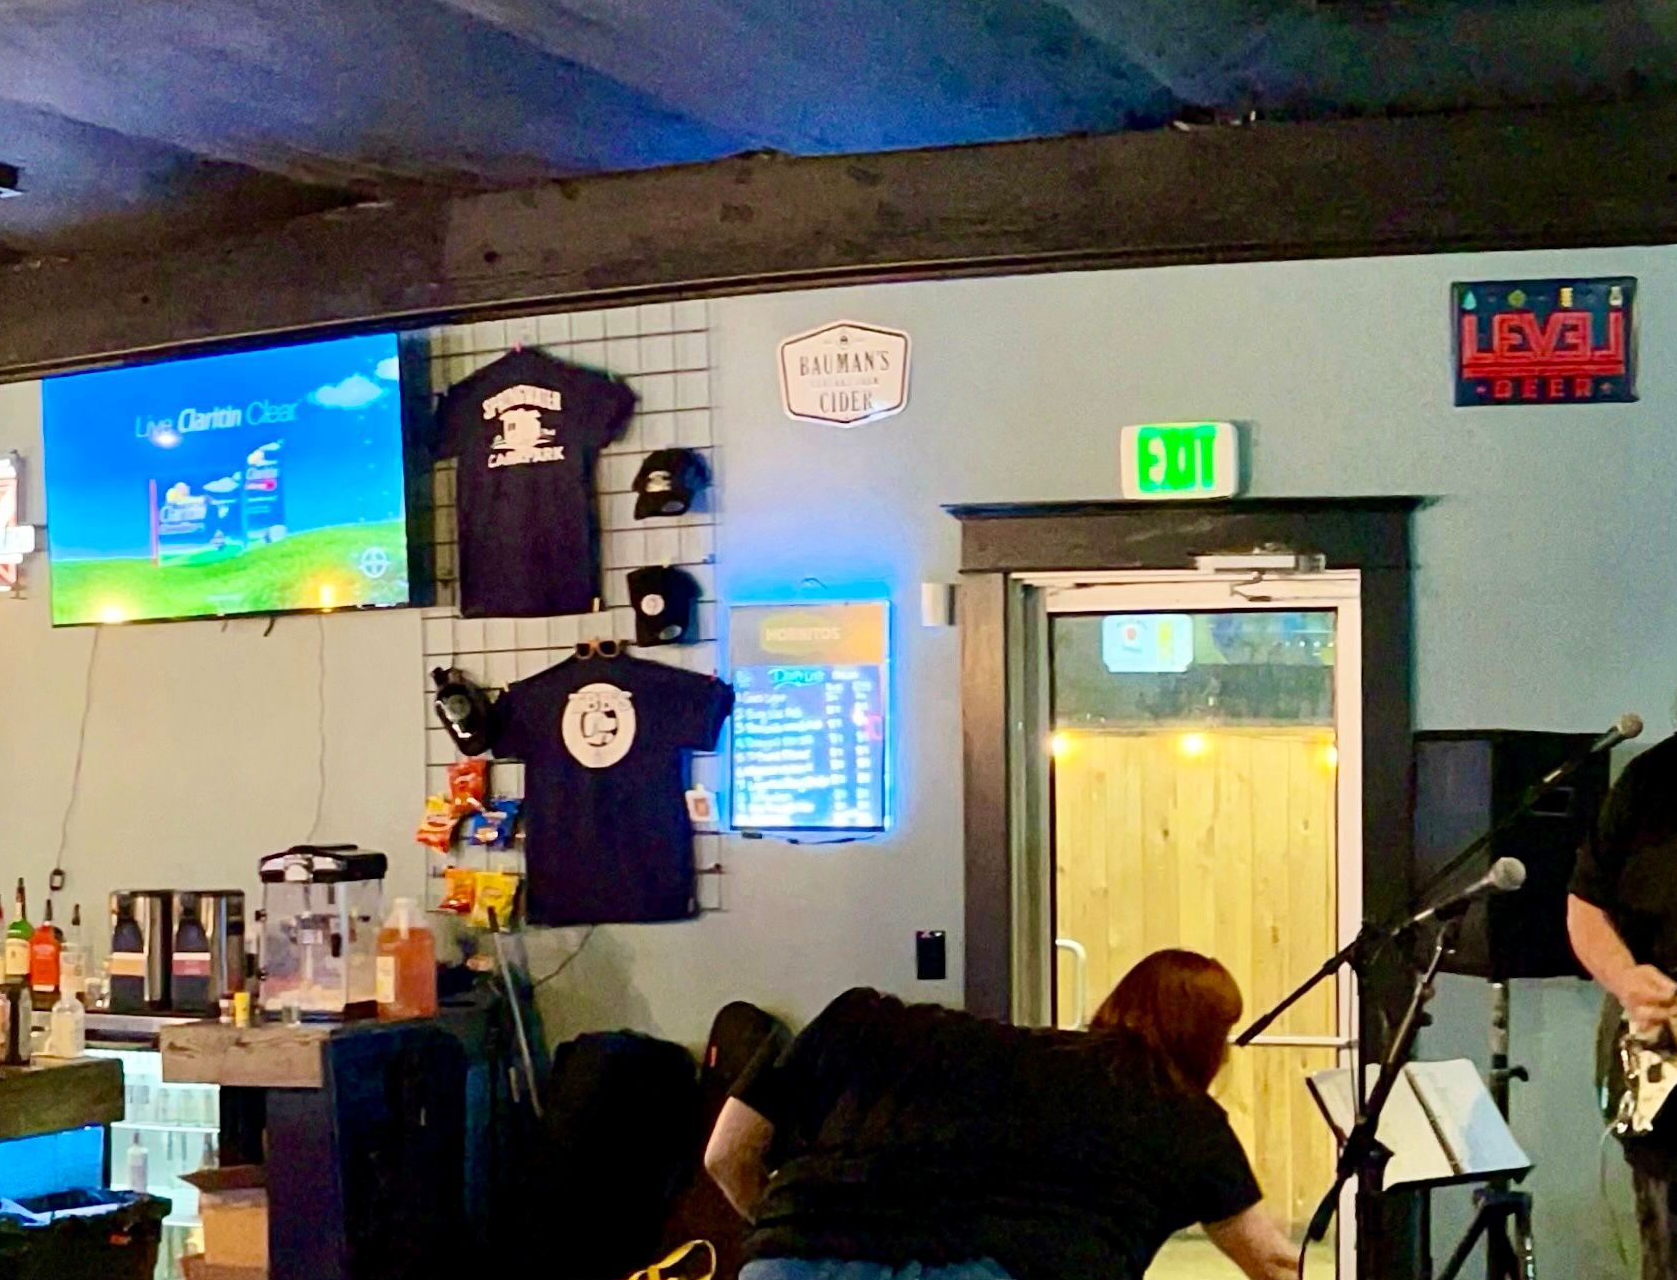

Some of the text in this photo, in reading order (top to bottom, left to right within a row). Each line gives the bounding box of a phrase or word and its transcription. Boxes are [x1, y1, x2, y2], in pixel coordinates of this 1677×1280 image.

[799, 350, 891, 376] BAUMAN'S
[819, 390, 874, 414] CIDER
[1494, 378, 1594, 400] BEER
[178, 405, 243, 434] Claritin
[1138, 425, 1216, 492] EXIT
